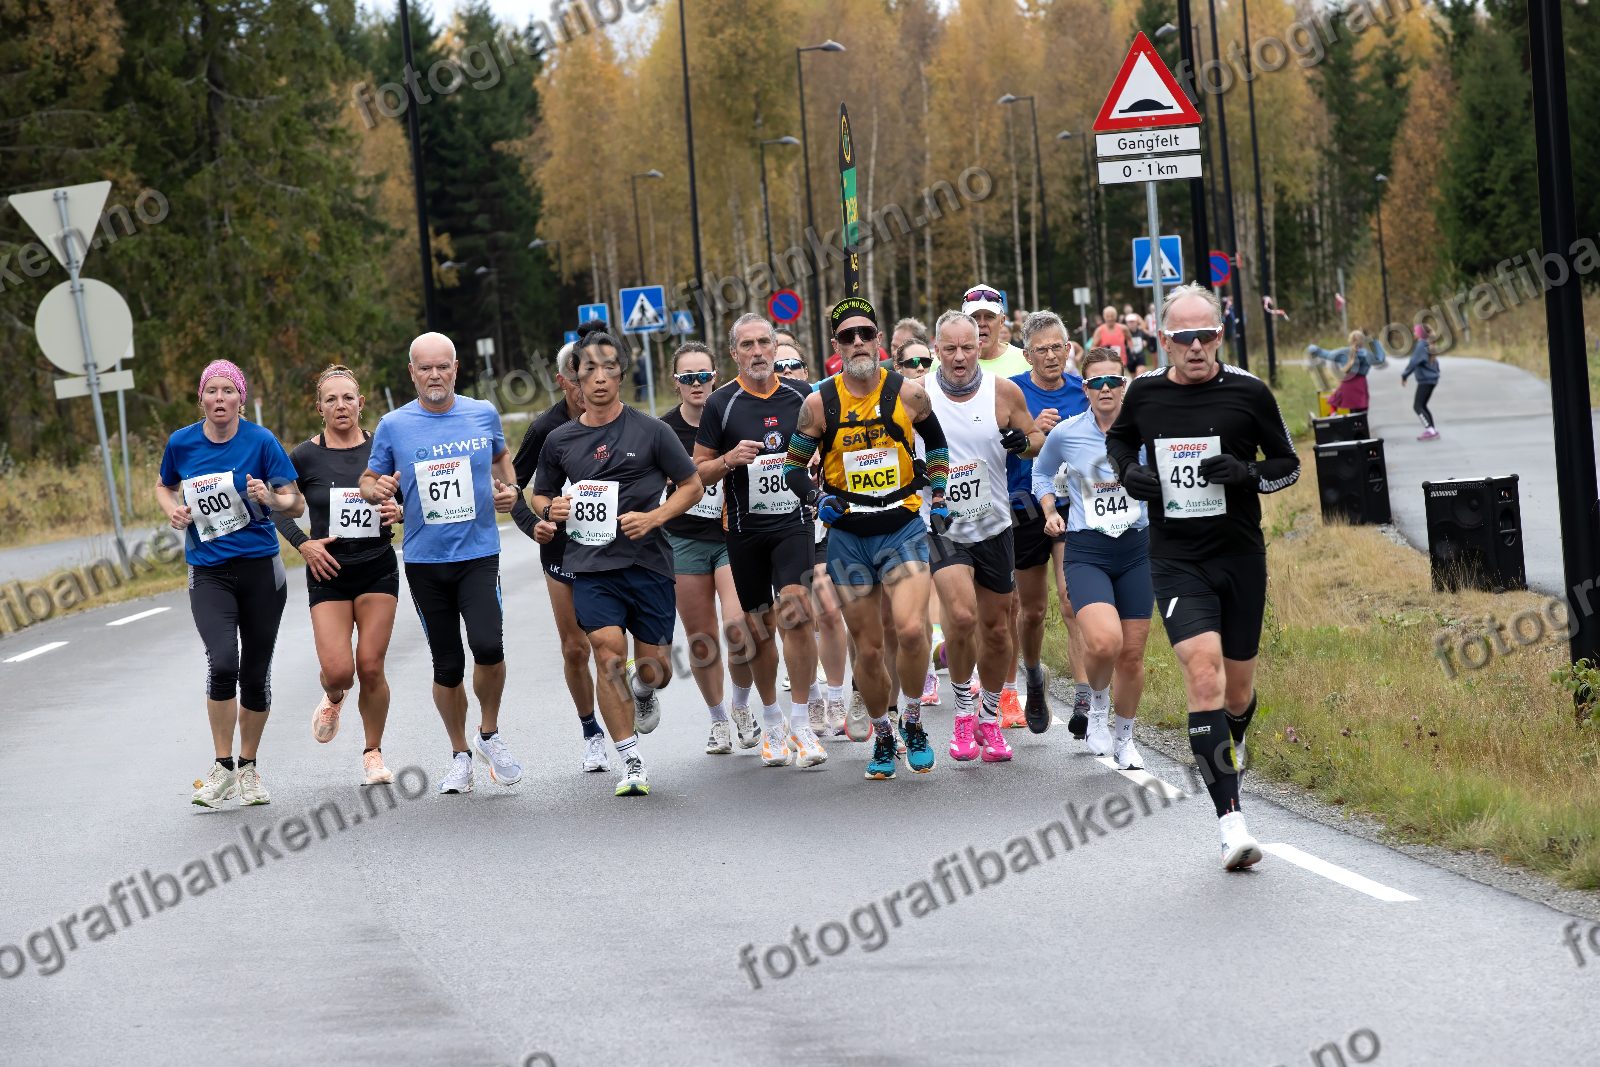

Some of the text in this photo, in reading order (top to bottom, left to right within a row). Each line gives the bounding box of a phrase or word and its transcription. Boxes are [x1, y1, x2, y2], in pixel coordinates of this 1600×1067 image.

[1118, 134, 1180, 152] Gangfelt
[1122, 165, 1132, 178] 0
[1147, 163, 1153, 176] 1
[1157, 162, 1178, 176] km
[432, 437, 488, 457] HYWER
[1167, 443, 1208, 452] NORGES
[856, 450, 888, 462] NORGES
[1173, 450, 1202, 459] LØPET
[426, 461, 461, 472] NORGES
[859, 457, 884, 467] LØPET
[431, 467, 456, 477] LØPET
[950, 469, 975, 480] LØPET
[1170, 465, 1209, 489] 435
[192, 476, 222, 488] NORGES
[758, 474, 791, 495] 380
[851, 469, 896, 490] PACE
[196, 482, 219, 494] LØPET
[428, 478, 462, 502] 671
[577, 484, 609, 492] NORGES
[579, 490, 603, 498] LØPET
[948, 479, 981, 502] 697
[197, 491, 232, 516] 600
[1094, 495, 1129, 517] 644
[1184, 497, 1223, 508] Aurskog
[444, 505, 474, 516] Aurskog
[574, 501, 607, 523] 838
[339, 508, 372, 528] 542
[585, 530, 614, 540] Aurskog
